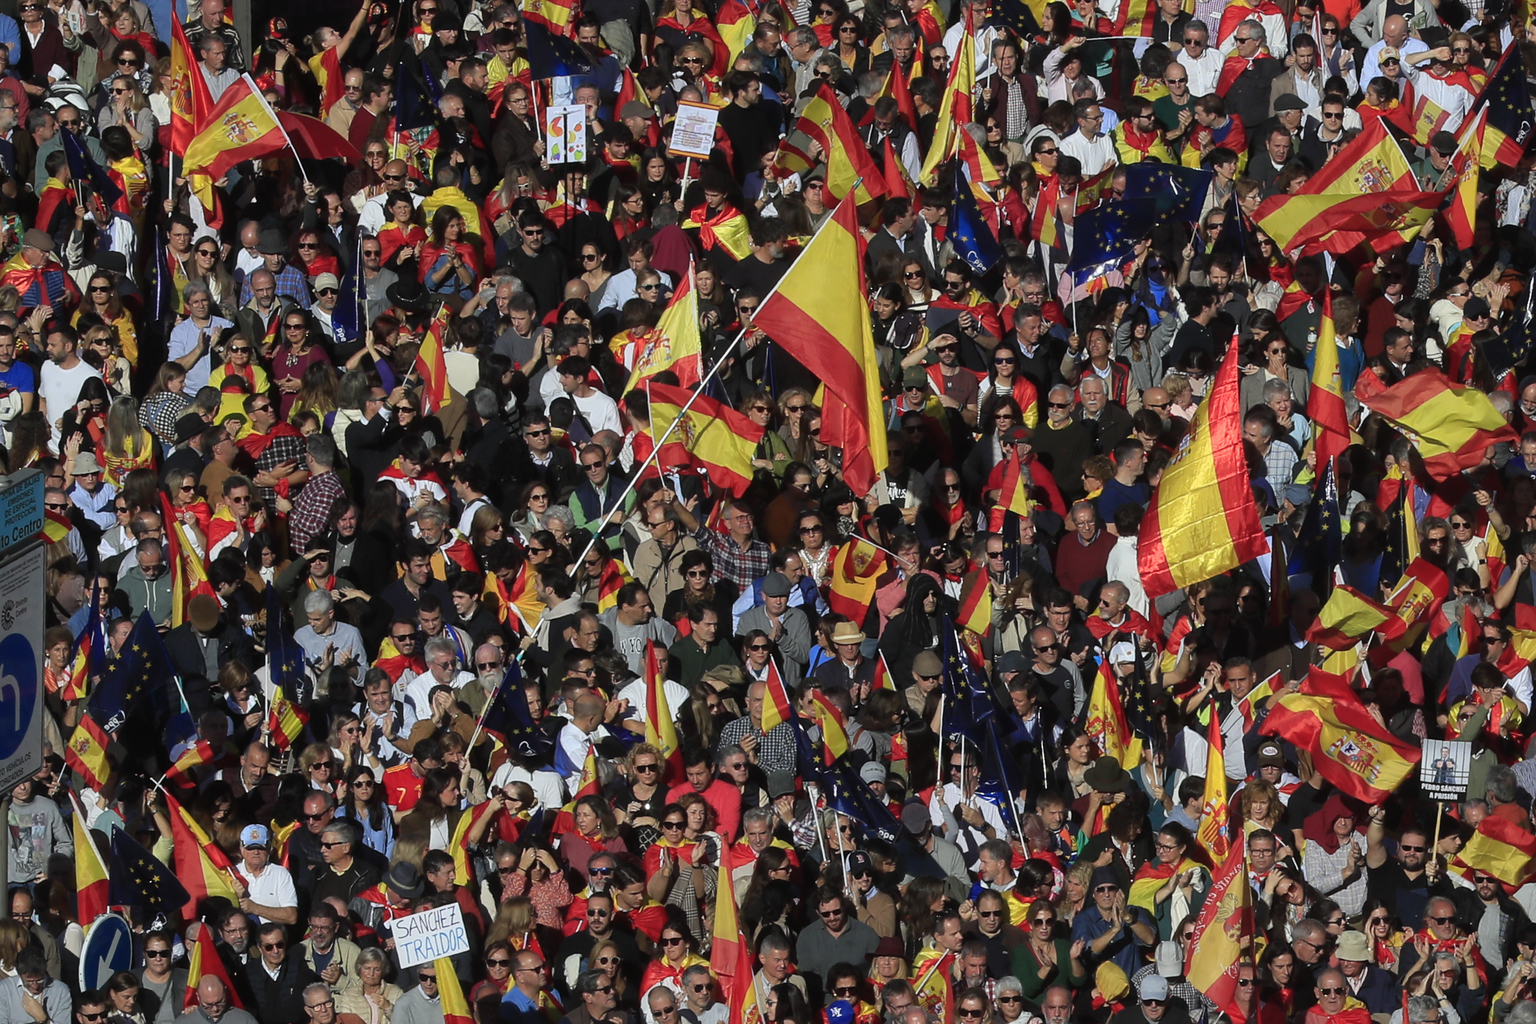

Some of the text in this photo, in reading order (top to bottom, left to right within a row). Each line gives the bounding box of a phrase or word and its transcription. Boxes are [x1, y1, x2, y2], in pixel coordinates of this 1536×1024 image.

[973, 258, 988, 272] ppe
[335, 326, 347, 343] ppe
[8, 488, 35, 507] EMISIONES
[5, 498, 36, 518] DE ESPECIAL
[5, 506, 37, 527] PROTECCIÓN
[12, 518, 42, 542] Centro
[396, 787, 407, 804] 7
[1421, 783, 1467, 793] PEDRO SÁNCHEZ
[1434, 793, 1459, 801] PRISIÓN
[396, 905, 460, 939] SANCHEZ
[400, 927, 469, 965] TRAIDOR
[830, 1006, 843, 1018] NY
